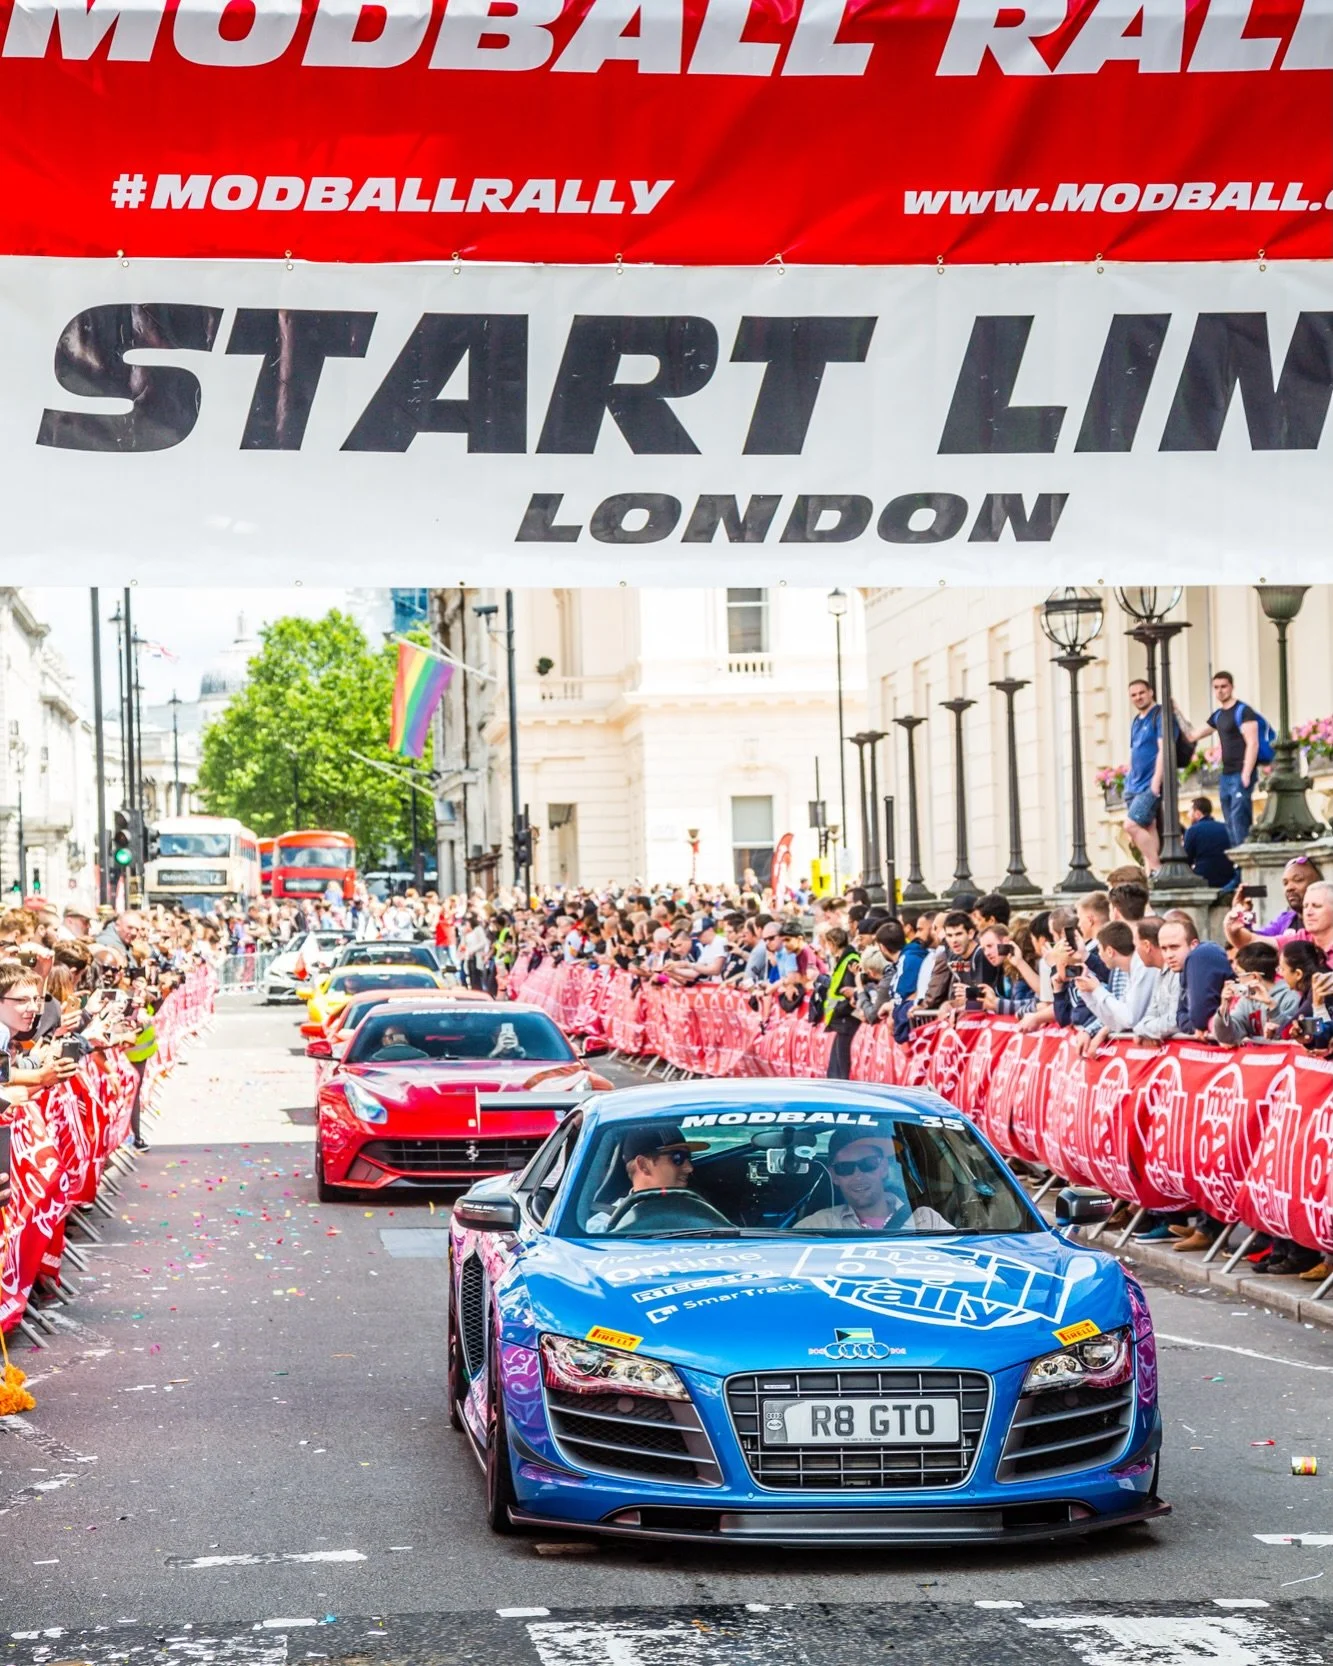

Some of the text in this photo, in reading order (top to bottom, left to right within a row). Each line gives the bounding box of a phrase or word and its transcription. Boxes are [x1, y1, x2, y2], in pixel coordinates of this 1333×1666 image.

[2, 0, 874, 77] MODBALL
[111, 173, 674, 215] #MODBALLRALLY
[903, 181, 1333, 215] www.MODBALL.
[36, 303, 878, 455] START
[514, 492, 1069, 544] LONDON
[681, 1111, 966, 1132] MODBALL 35
[591, 1328, 637, 1347] PIRELLI
[1058, 1322, 1096, 1342] PIRELLI
[811, 1404, 935, 1437] R8 GTO
